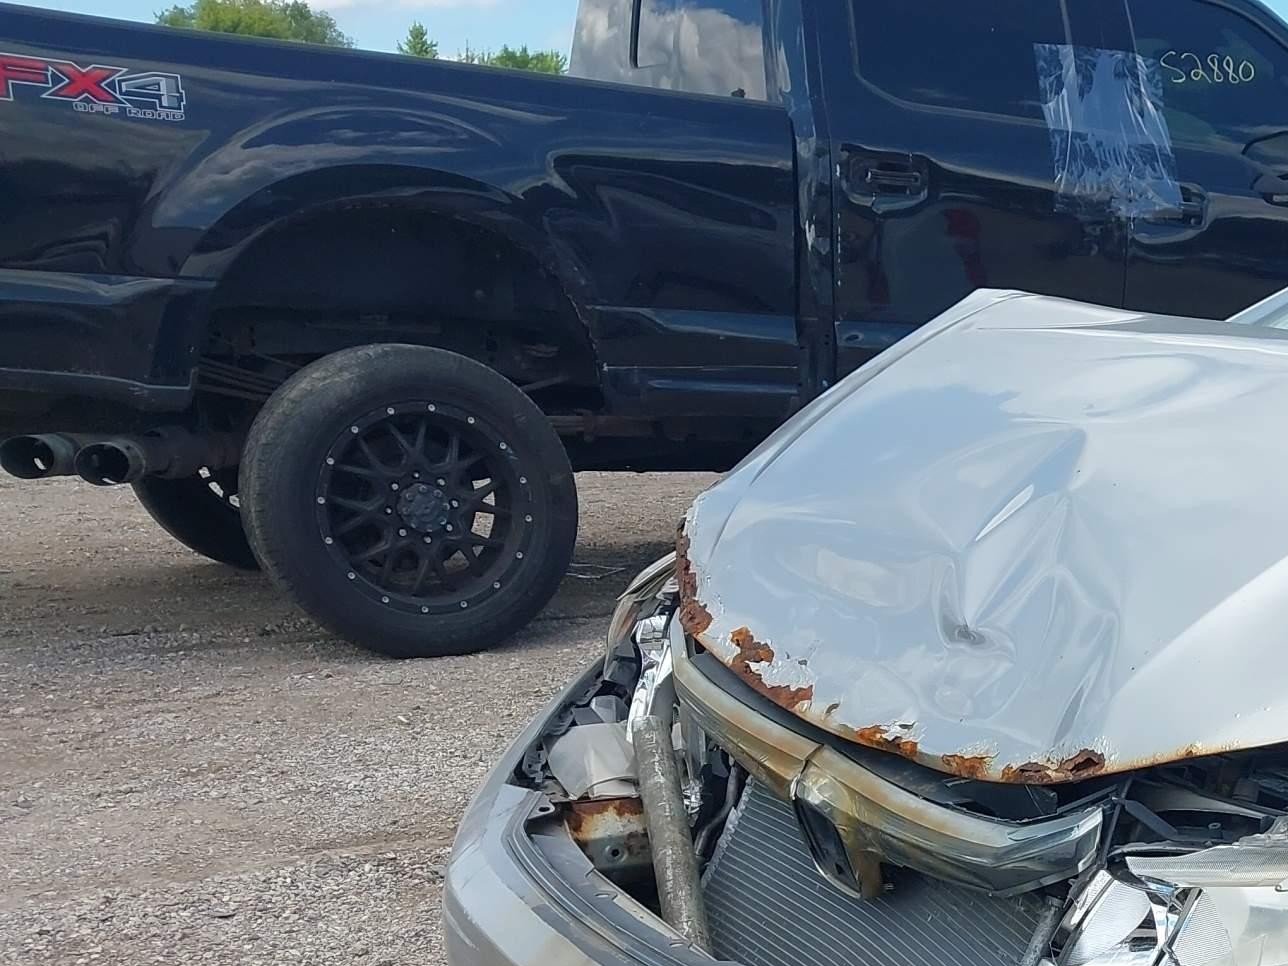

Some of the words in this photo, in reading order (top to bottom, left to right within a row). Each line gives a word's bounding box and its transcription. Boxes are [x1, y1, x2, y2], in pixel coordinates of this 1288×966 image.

[0, 52, 186, 113] FX4
[73, 101, 119, 114] OFF
[127, 107, 186, 121] ROAD
